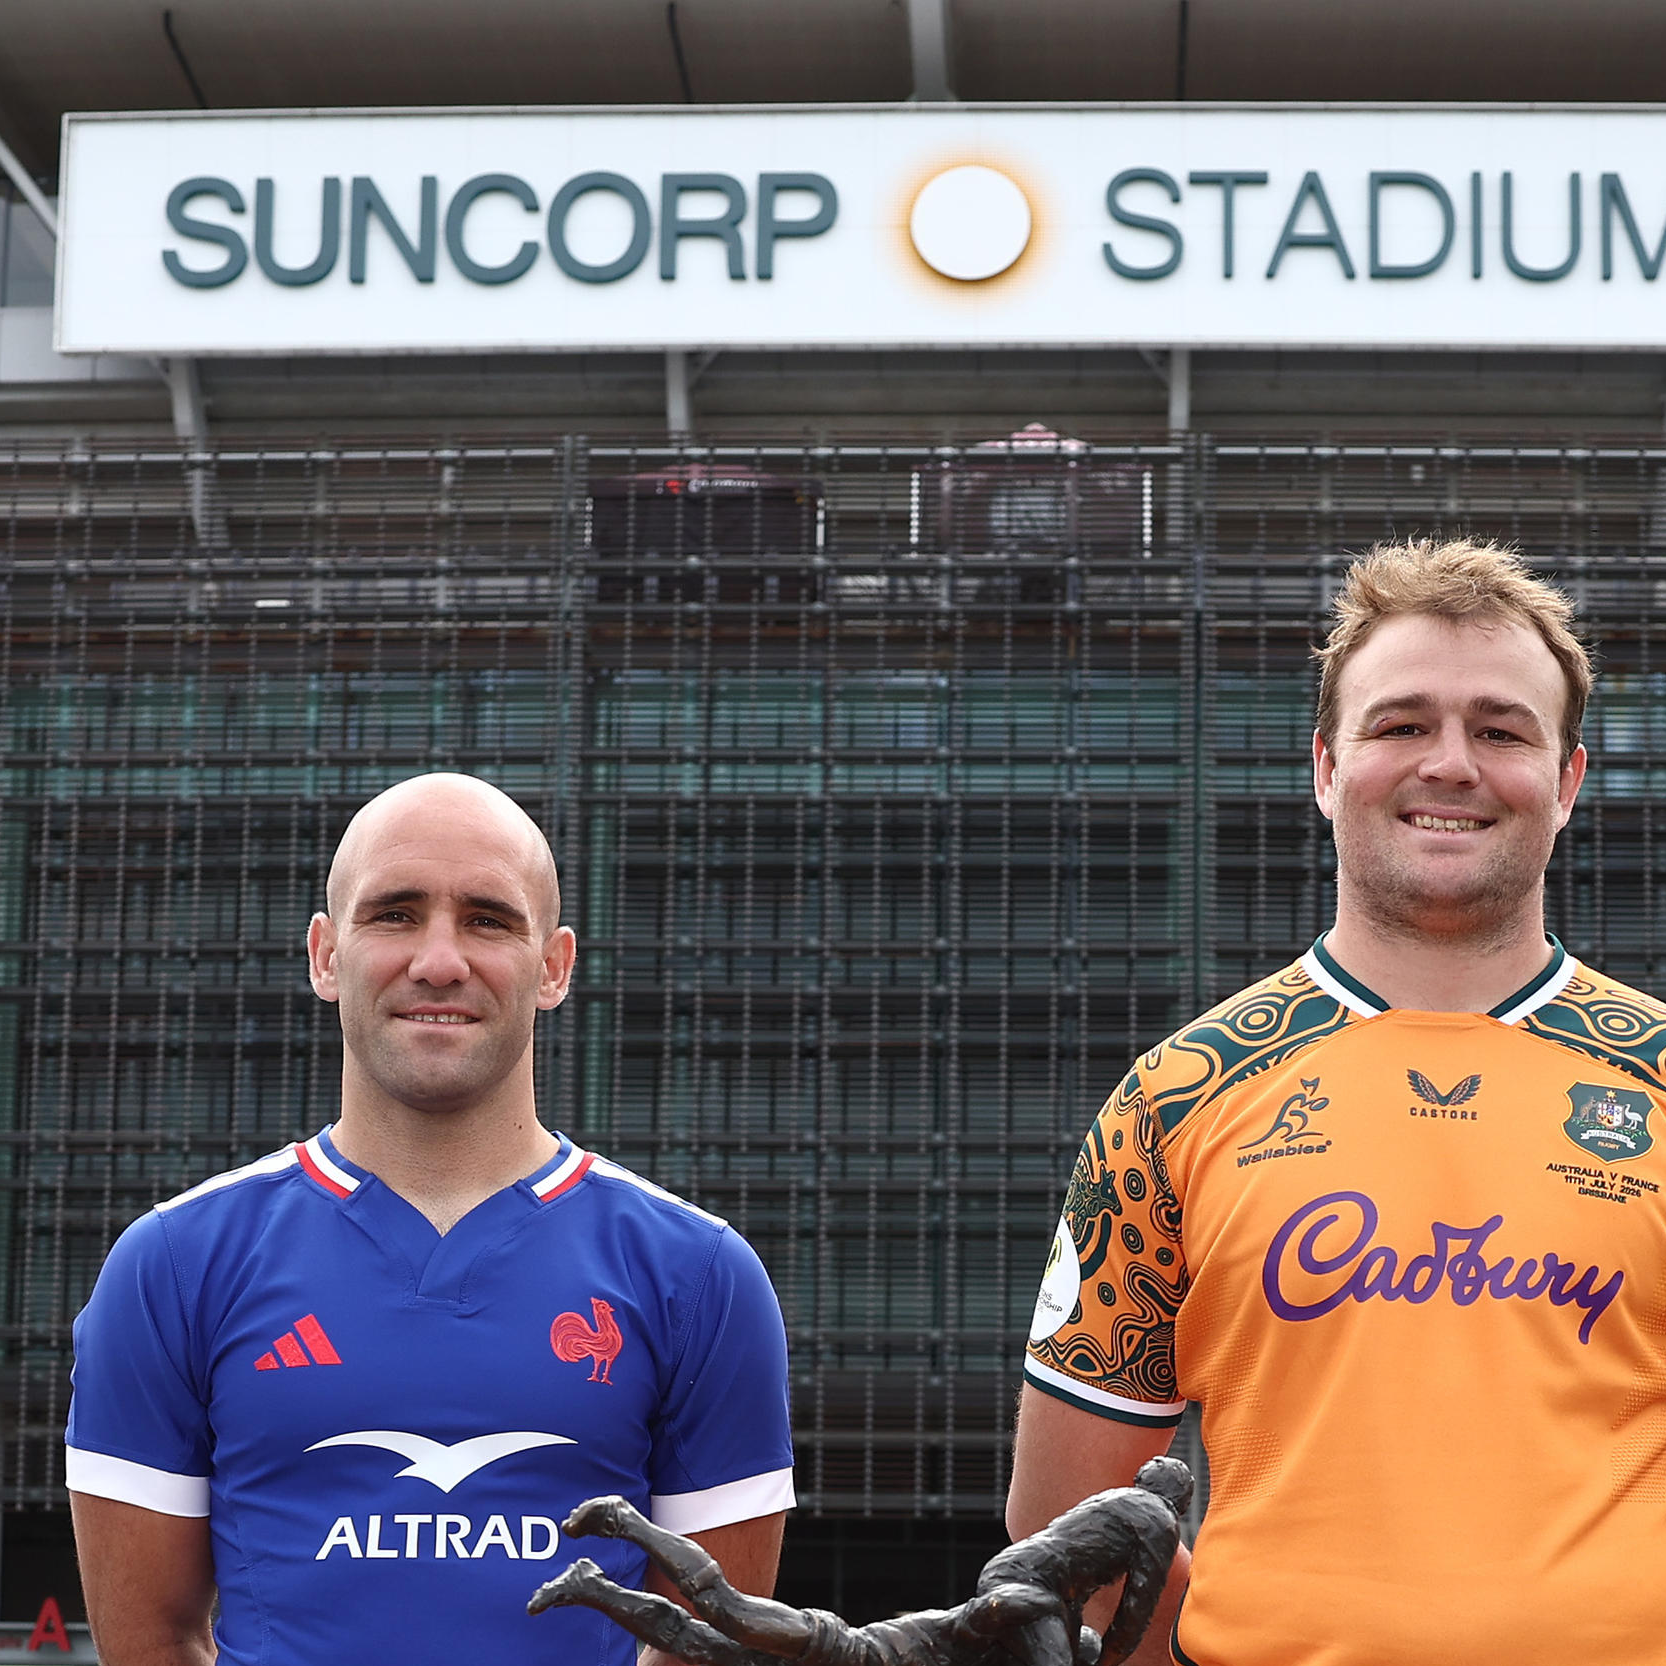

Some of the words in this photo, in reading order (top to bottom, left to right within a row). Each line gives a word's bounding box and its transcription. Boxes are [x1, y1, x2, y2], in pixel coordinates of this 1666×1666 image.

[160, 170, 840, 292] SUNCORP
[1410, 1107, 1478, 1121] CASTORE
[1236, 1141, 1328, 1168] Wallabies
[1545, 1162, 1605, 1179] AUSTRALIA
[1609, 1171, 1618, 1181] V
[1621, 1175, 1660, 1193] FRANCE
[1564, 1174, 1586, 1186] 11TH
[1590, 1179, 1616, 1191] JULY
[1619, 1184, 1642, 1198] 2026
[1578, 1186, 1627, 1204] BRISBANE
[1263, 1189, 1624, 1344] Cadbury
[314, 1514, 560, 1561] ALTRAD
[27, 1597, 71, 1652] A
